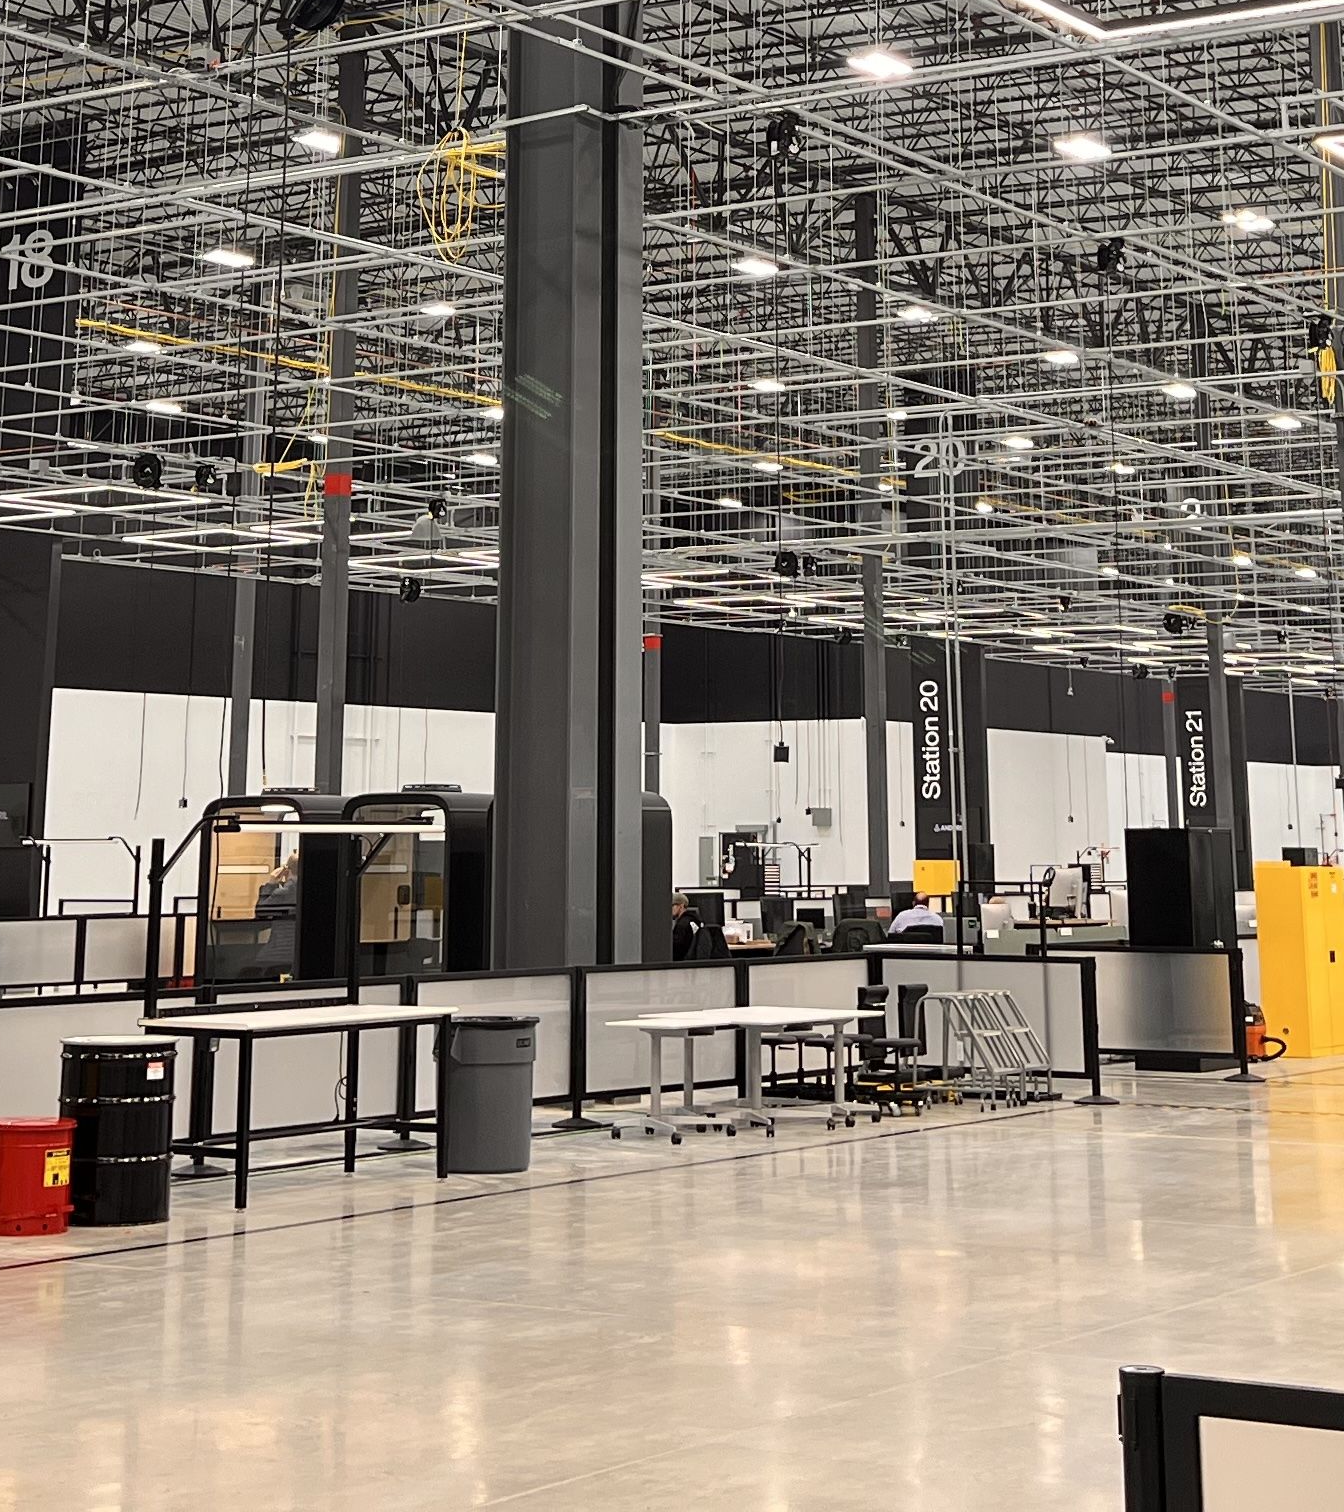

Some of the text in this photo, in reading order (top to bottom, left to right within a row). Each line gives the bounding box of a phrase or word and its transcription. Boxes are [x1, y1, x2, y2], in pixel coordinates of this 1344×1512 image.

[1, 229, 54, 291] 18
[914, 439, 965, 476] 20
[919, 680, 941, 800] Station 20
[1185, 710, 1207, 807] Station 21
